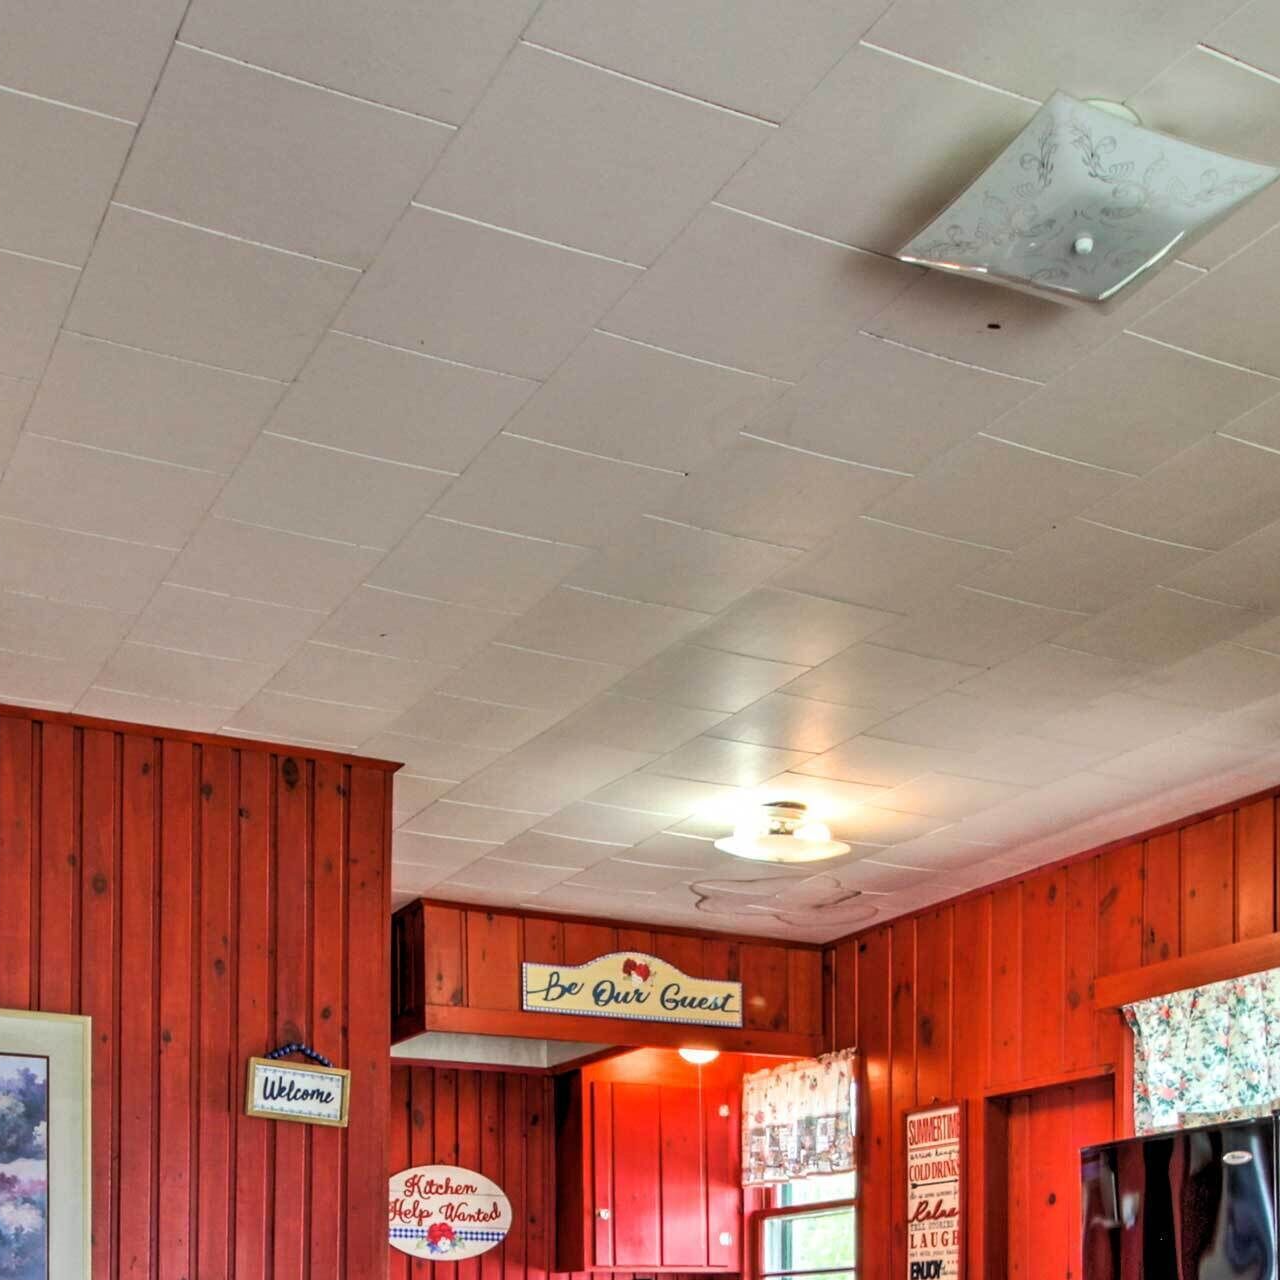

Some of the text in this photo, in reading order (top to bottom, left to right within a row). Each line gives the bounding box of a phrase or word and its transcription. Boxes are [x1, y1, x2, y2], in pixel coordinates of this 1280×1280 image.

[526, 970, 740, 1013] Be Our Guest
[262, 1075, 335, 1104] Welcome
[909, 1163, 930, 1181] COLD
[403, 1173, 478, 1200] Kitchen
[388, 1197, 502, 1227] Help Wanted
[910, 1259, 942, 1280] ENJOY
